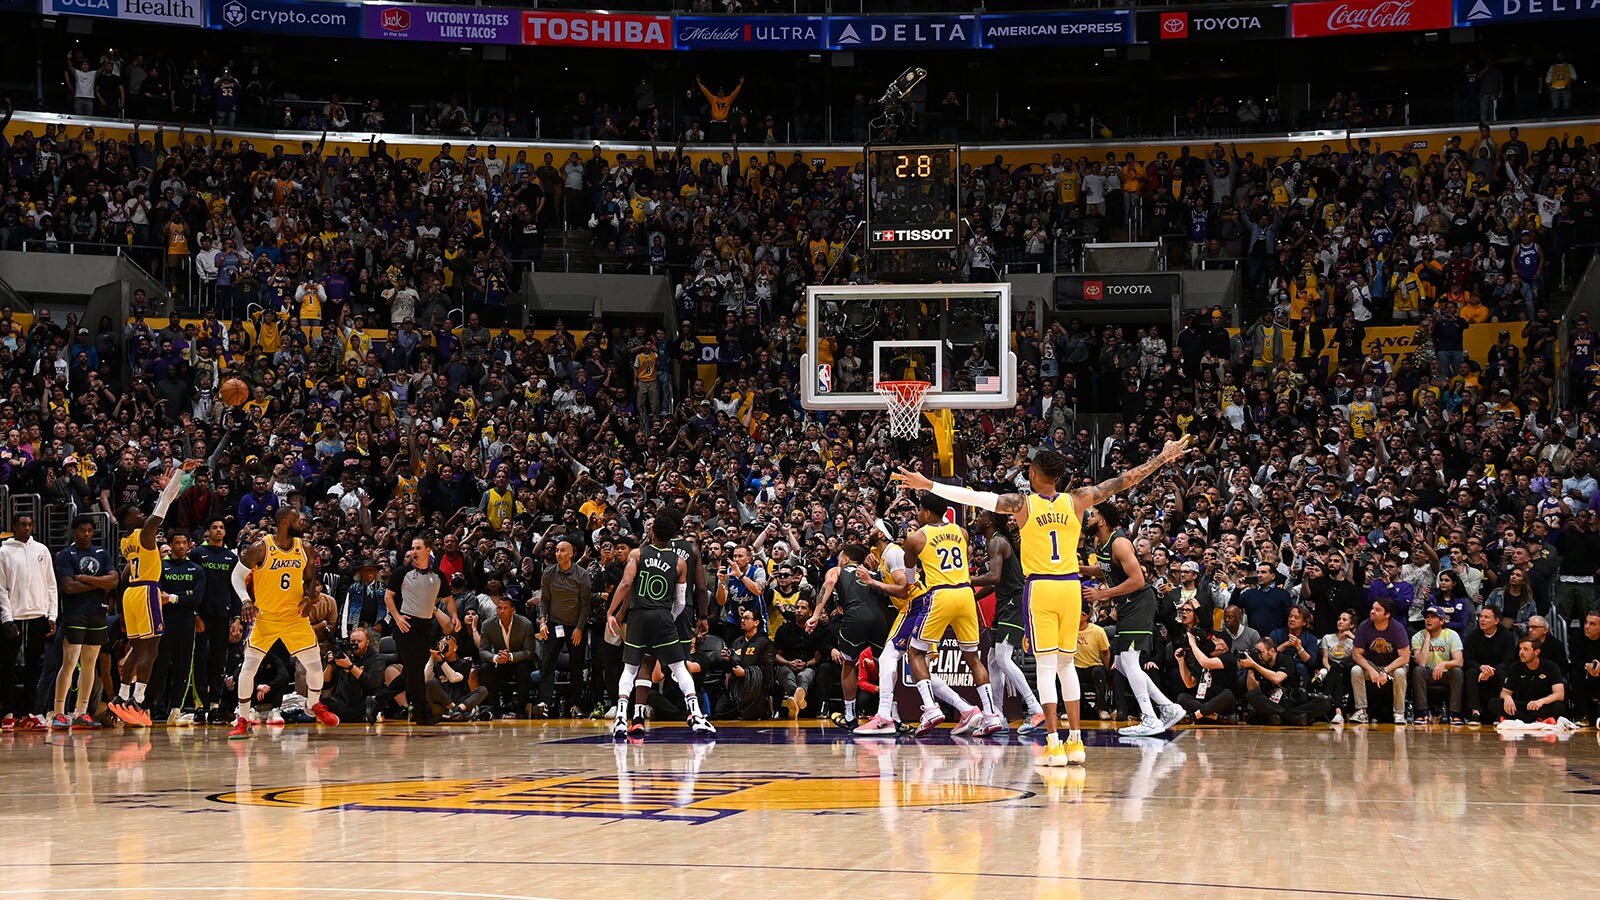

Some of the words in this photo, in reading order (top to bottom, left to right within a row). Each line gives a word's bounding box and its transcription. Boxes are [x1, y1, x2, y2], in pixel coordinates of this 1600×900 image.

[125, 0, 194, 18] Health
[1327, 1, 1414, 30] Coca-Cola
[251, 9, 346, 25] crypto.com
[383, 10, 408, 28] Jack
[426, 11, 471, 25] VICTORY
[472, 13, 509, 26] TASTES
[1194, 16, 1261, 31] TOYOTA
[440, 25, 464, 38] LIKE
[465, 27, 497, 39] TACOS
[528, 17, 665, 44] TOSHIBA
[679, 26, 741, 41] Michelob
[756, 26, 816, 40] ULTRA
[870, 24, 966, 41] DELTA
[987, 24, 1057, 37] AMERICAN
[1061, 22, 1122, 34] EXPRESS
[1412, 141, 1428, 149] 208
[895, 155, 931, 178] 2.8
[895, 229, 954, 241] TISSOT
[1524, 257, 1531, 265] 6
[1106, 285, 1152, 294] TOYOTA
[1575, 346, 1589, 356] 24
[1036, 514, 1069, 527] RUSSELL
[1050, 530, 1060, 563] 1
[270, 558, 302, 570] LAKERS
[644, 557, 672, 573] CONLEY
[936, 546, 963, 571] 28
[202, 562, 230, 571] WOLVES
[164, 573, 193, 581] WOLVES
[280, 572, 291, 590] 6
[638, 571, 669, 600] 10
[942, 639, 959, 647] AT&
[745, 646, 756, 656] 22
[928, 650, 981, 673] PLAY-
